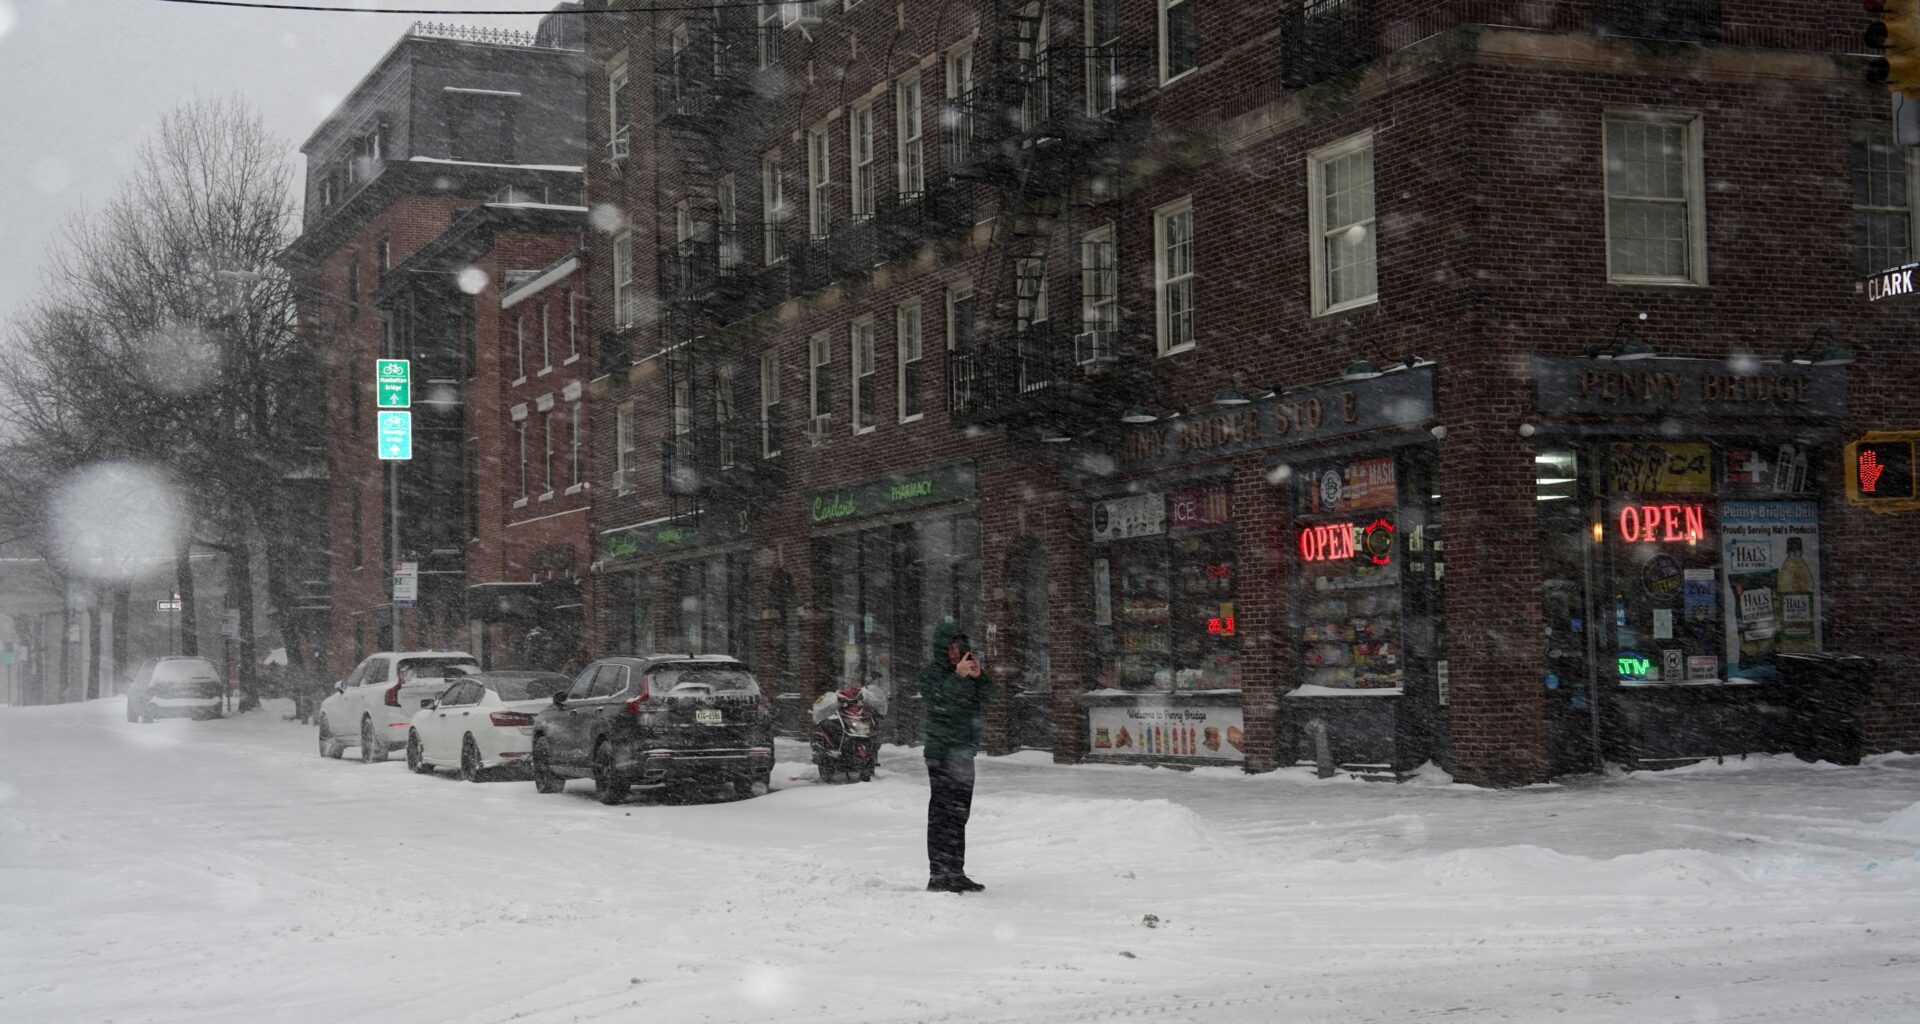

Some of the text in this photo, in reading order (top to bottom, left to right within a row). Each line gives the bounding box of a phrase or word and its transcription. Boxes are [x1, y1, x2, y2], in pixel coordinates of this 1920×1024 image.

[1868, 270, 1913, 301] CLARK
[1579, 369, 1811, 401] PENNY BRIDGE
[1180, 409, 1261, 449] BRIDGE
[1368, 461, 1395, 486] MASH
[1667, 454, 1706, 475] C4
[890, 479, 933, 501] PHARMACY
[1174, 501, 1195, 521] ICE
[1723, 505, 1814, 521] Penny Bridge Deli
[1619, 503, 1705, 543] OPEN
[1722, 525, 1817, 536] Proudly Serving Hal's Products
[1301, 522, 1355, 561] OPEN
[1736, 546, 1767, 562] HAL'S
[1127, 708, 1207, 724] Welcome to Penny Bridge
